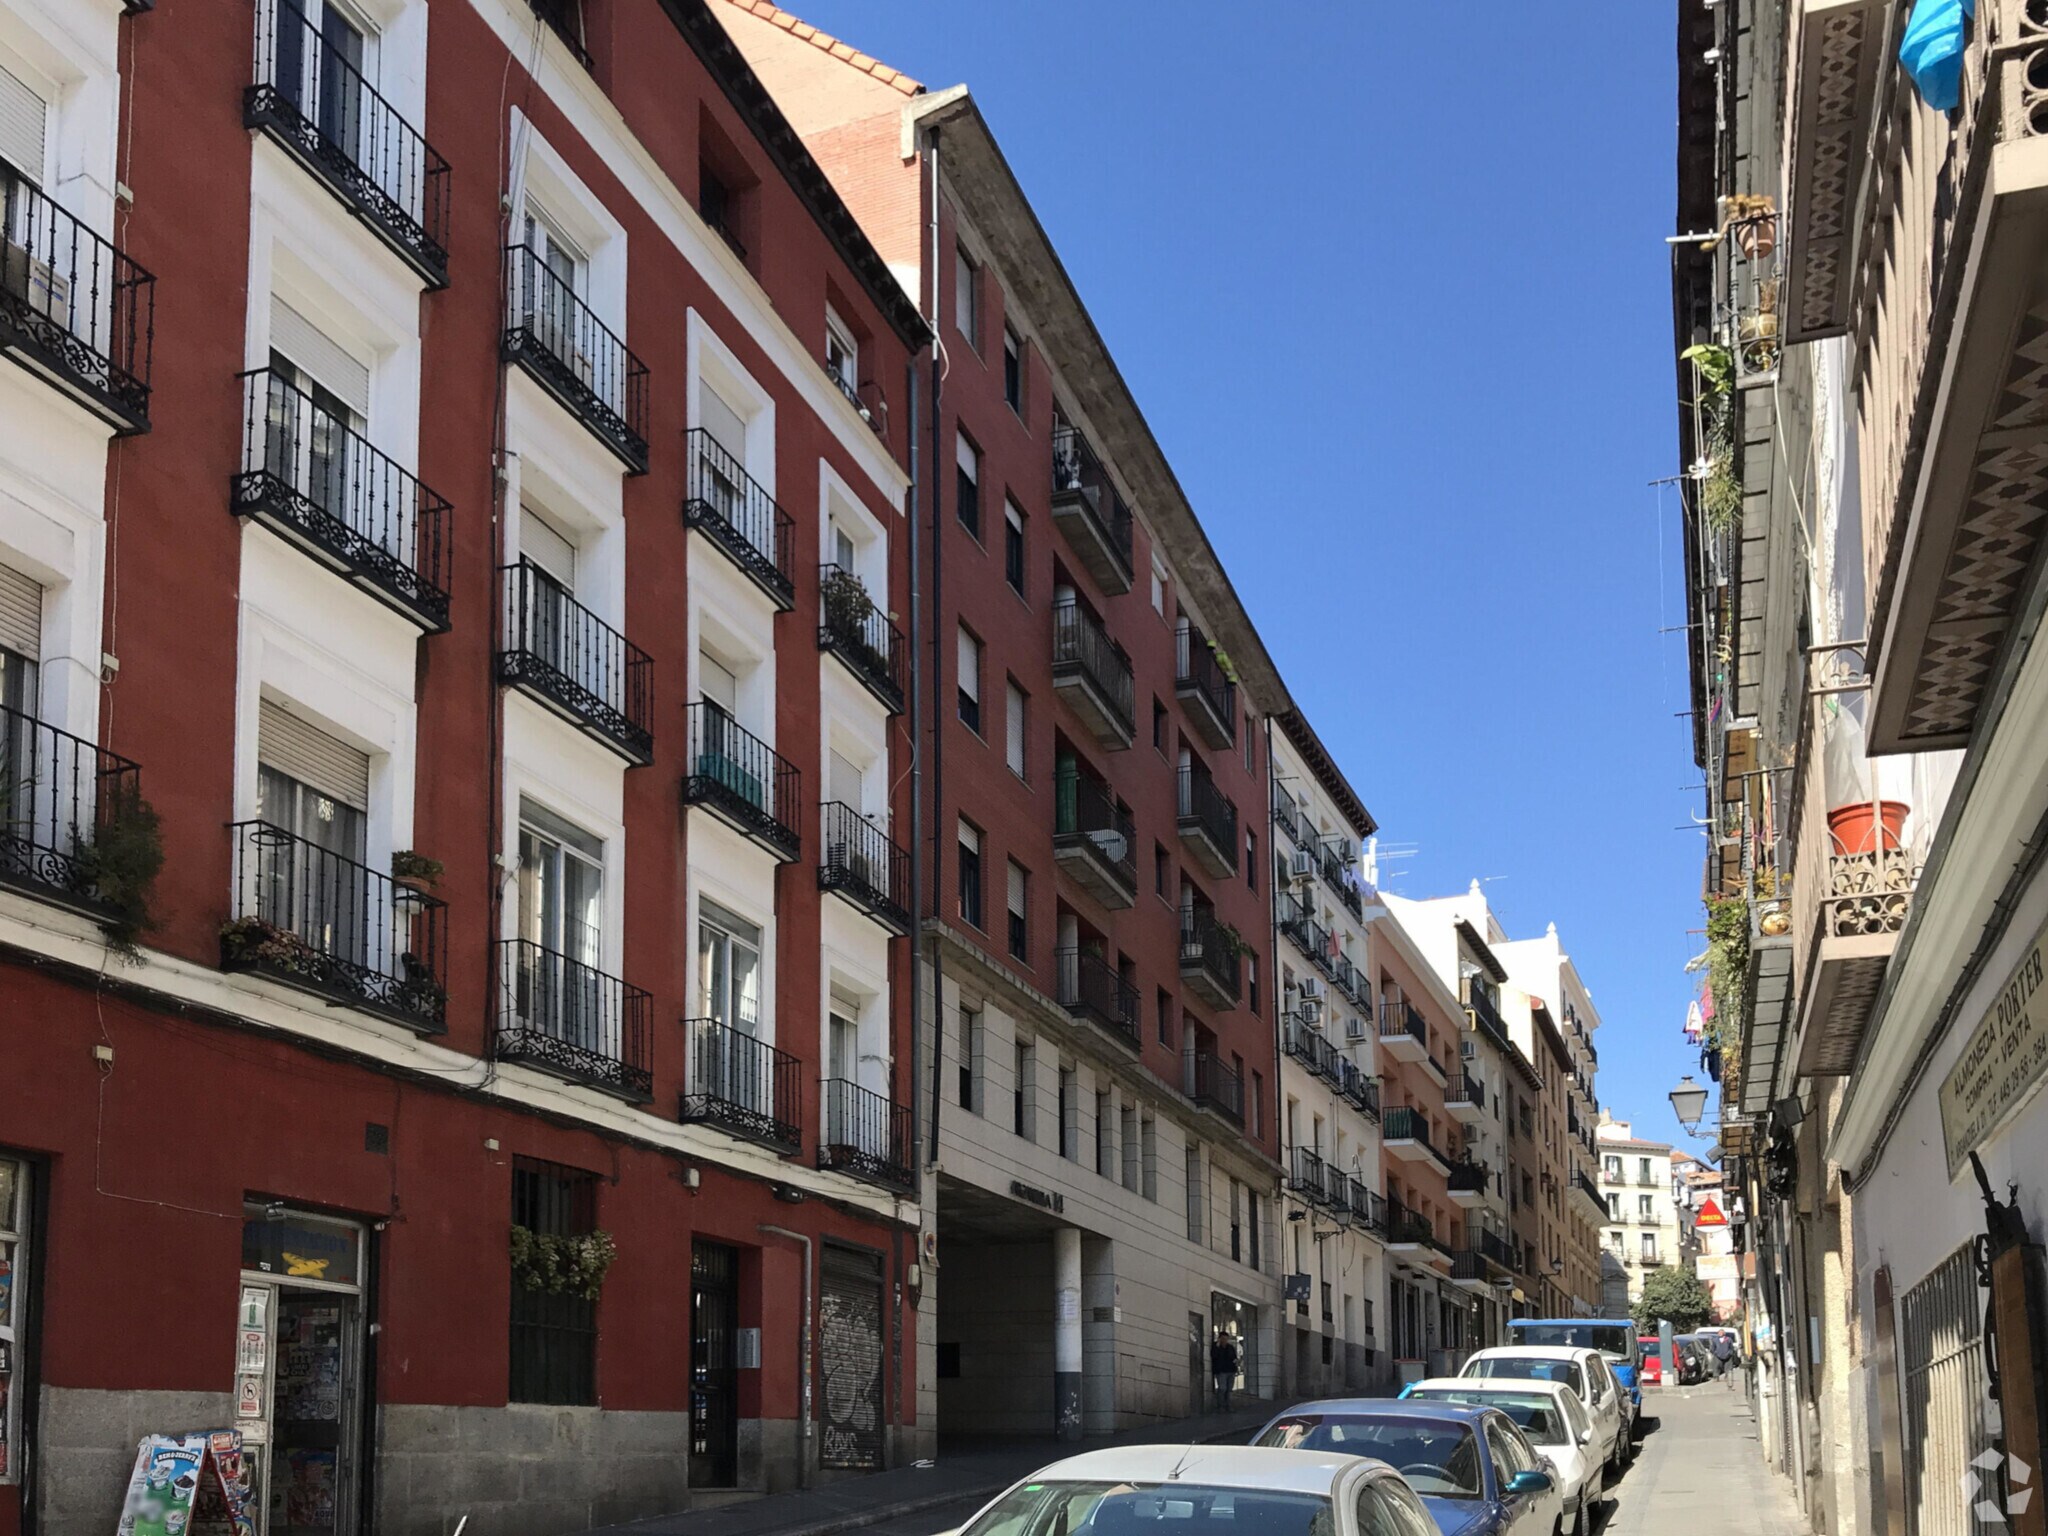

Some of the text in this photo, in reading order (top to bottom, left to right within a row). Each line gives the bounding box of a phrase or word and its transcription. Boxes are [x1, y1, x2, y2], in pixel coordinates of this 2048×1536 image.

[1954, 947, 2044, 1099] ALMONEDA PORTER
[1965, 1064, 1994, 1114] COMPRA
[2001, 1013, 2031, 1065] VENTA
